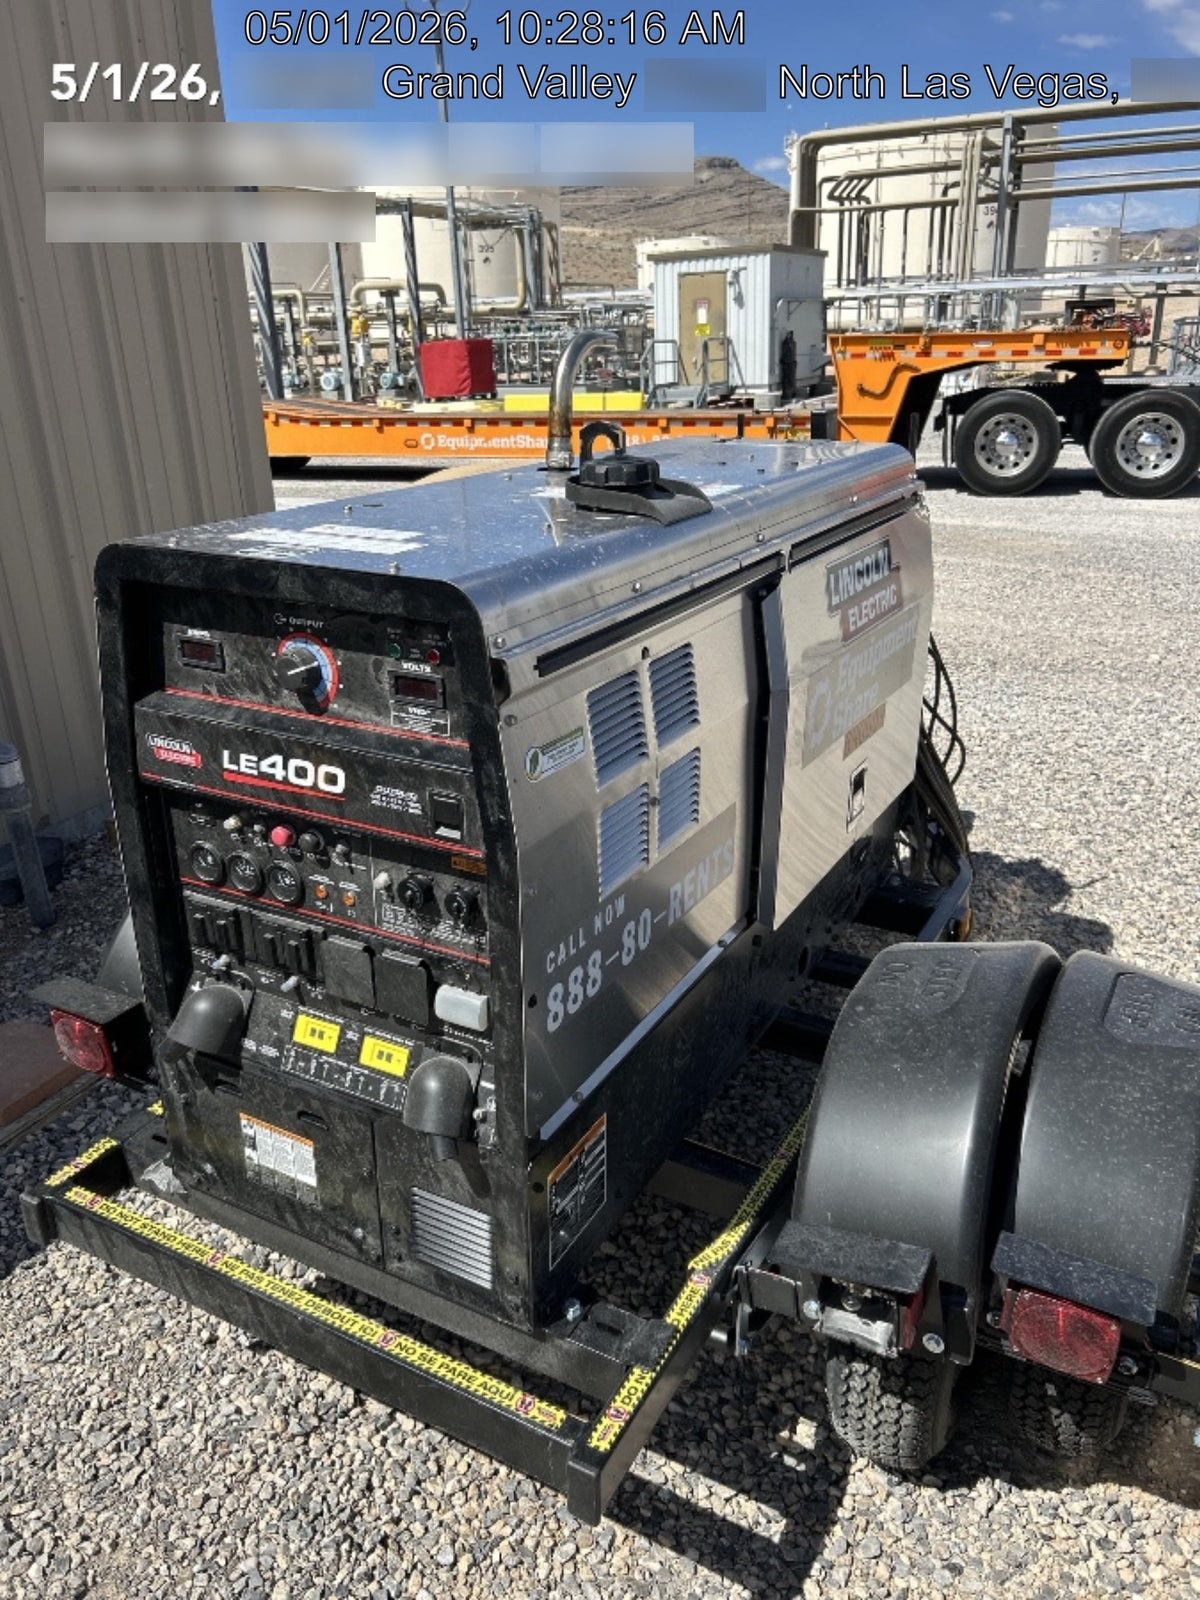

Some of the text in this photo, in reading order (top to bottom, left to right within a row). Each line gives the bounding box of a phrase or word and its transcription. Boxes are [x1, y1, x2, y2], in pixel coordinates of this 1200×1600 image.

[437, 434, 549, 452] EquipentSha
[829, 547, 890, 606] LINCOLN
[848, 584, 897, 632] ELECTRIC
[837, 612, 919, 694] Equipment
[832, 682, 880, 741] Share
[222, 749, 346, 794] LE400
[546, 894, 626, 974] CALL NOW
[547, 836, 735, 1033] 888-80-RENTS
[99, 1202, 211, 1258] DO NOT STAND HERE
[221, 1258, 379, 1338] NE PAS TENEZ DEBOUT ICI
[677, 1286, 702, 1320] HERE
[394, 1340, 417, 1356] NO
[417, 1350, 438, 1366] SE
[437, 1361, 479, 1386] PARE
[620, 1386, 639, 1406] DO
